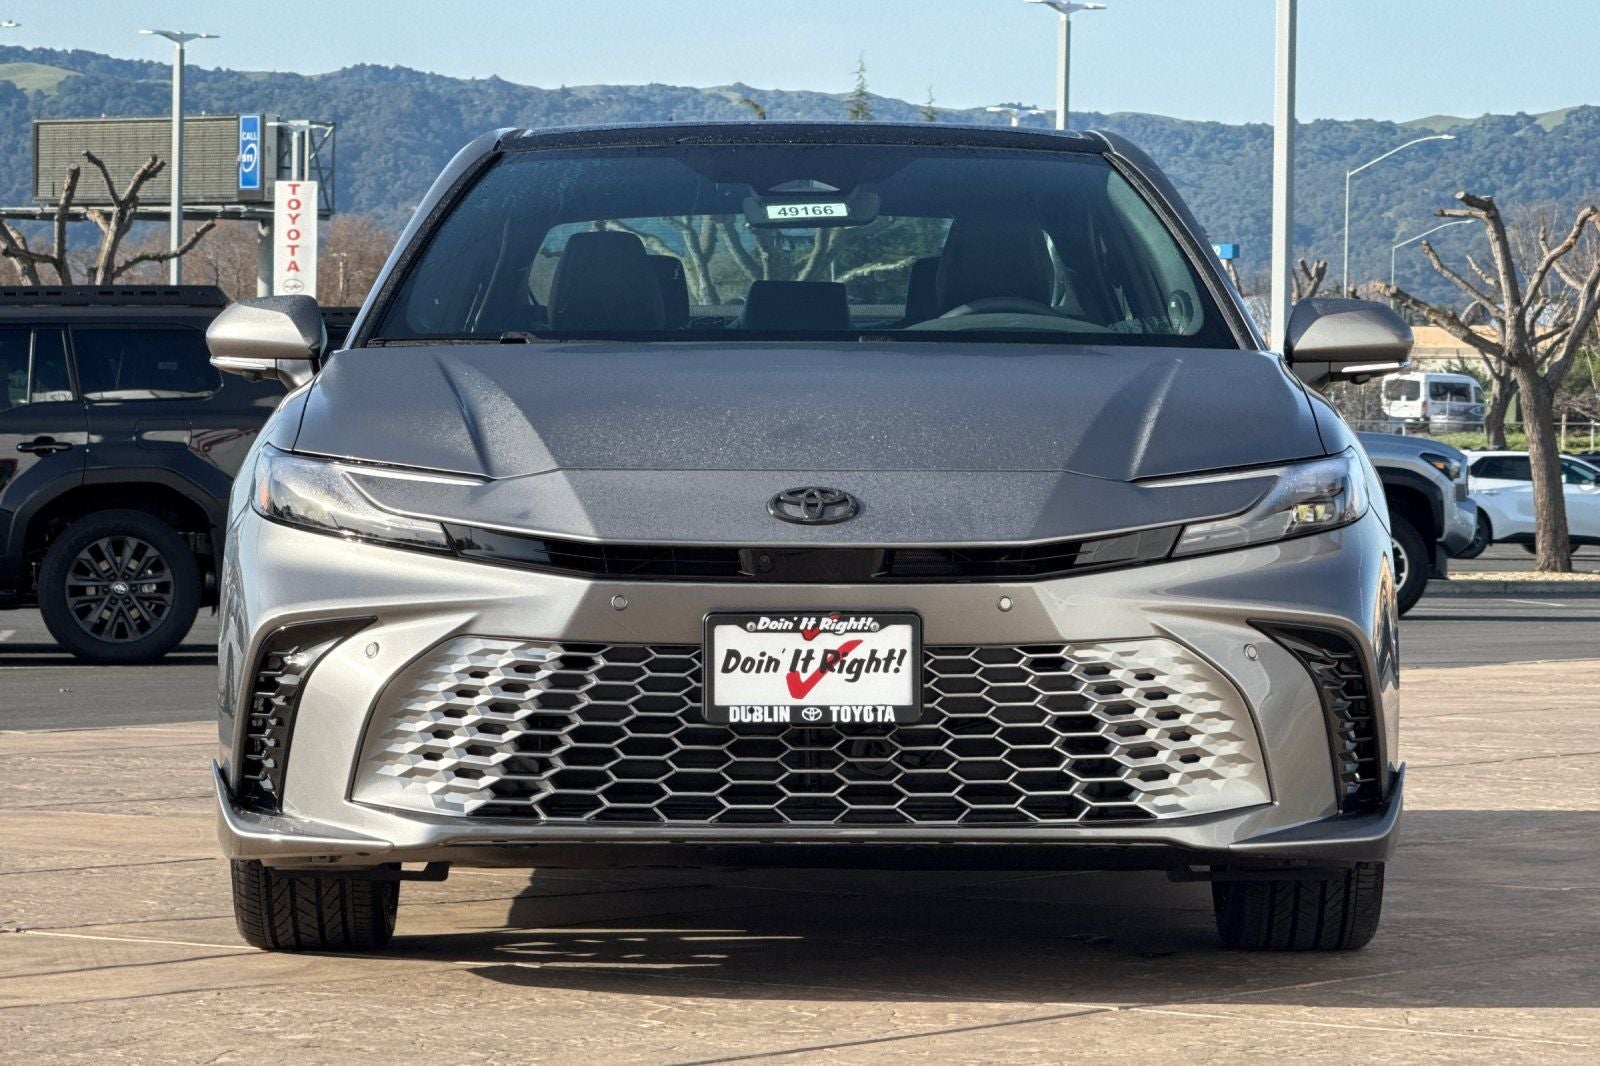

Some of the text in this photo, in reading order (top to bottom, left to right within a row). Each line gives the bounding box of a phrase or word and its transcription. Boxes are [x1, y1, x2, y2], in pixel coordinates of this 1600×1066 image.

[242, 132, 257, 141] CALL
[242, 154, 254, 163] 511
[778, 206, 834, 216] 49166
[287, 184, 301, 272] TOYOTA
[757, 616, 871, 634] Doin' It Right!
[721, 648, 907, 682] Doin' It Right!
[729, 706, 895, 722] DUBLIN TOYOTA
